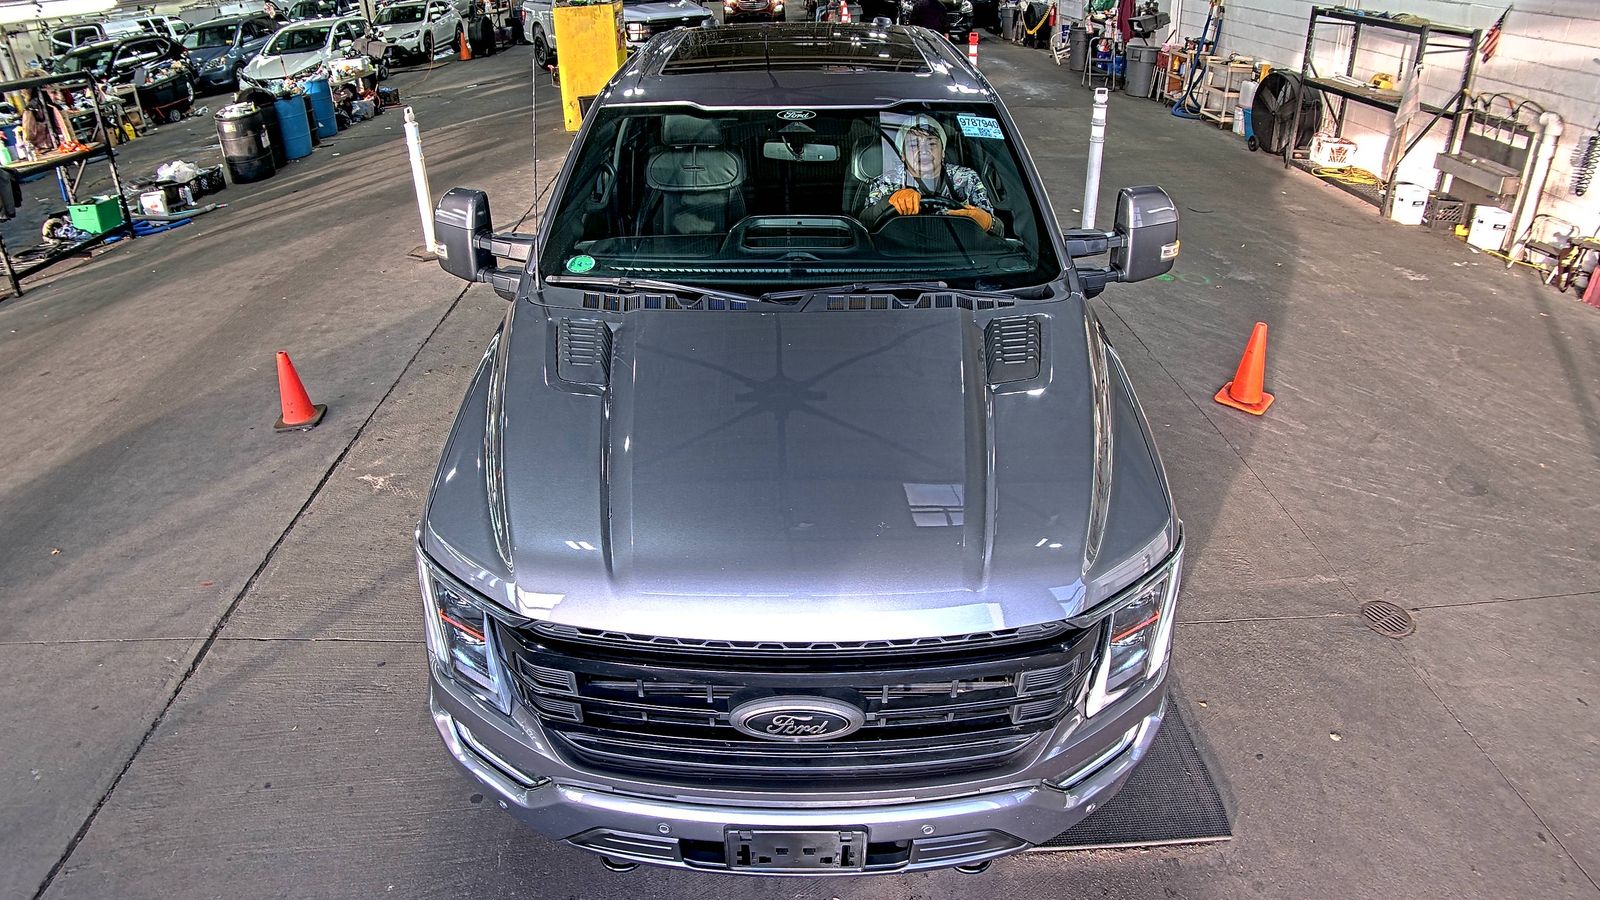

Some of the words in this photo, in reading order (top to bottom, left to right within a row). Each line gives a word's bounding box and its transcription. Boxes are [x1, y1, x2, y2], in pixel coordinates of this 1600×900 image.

[784, 110, 810, 119] Ford
[959, 117, 999, 128] 9787940
[766, 715, 829, 734] Ford
